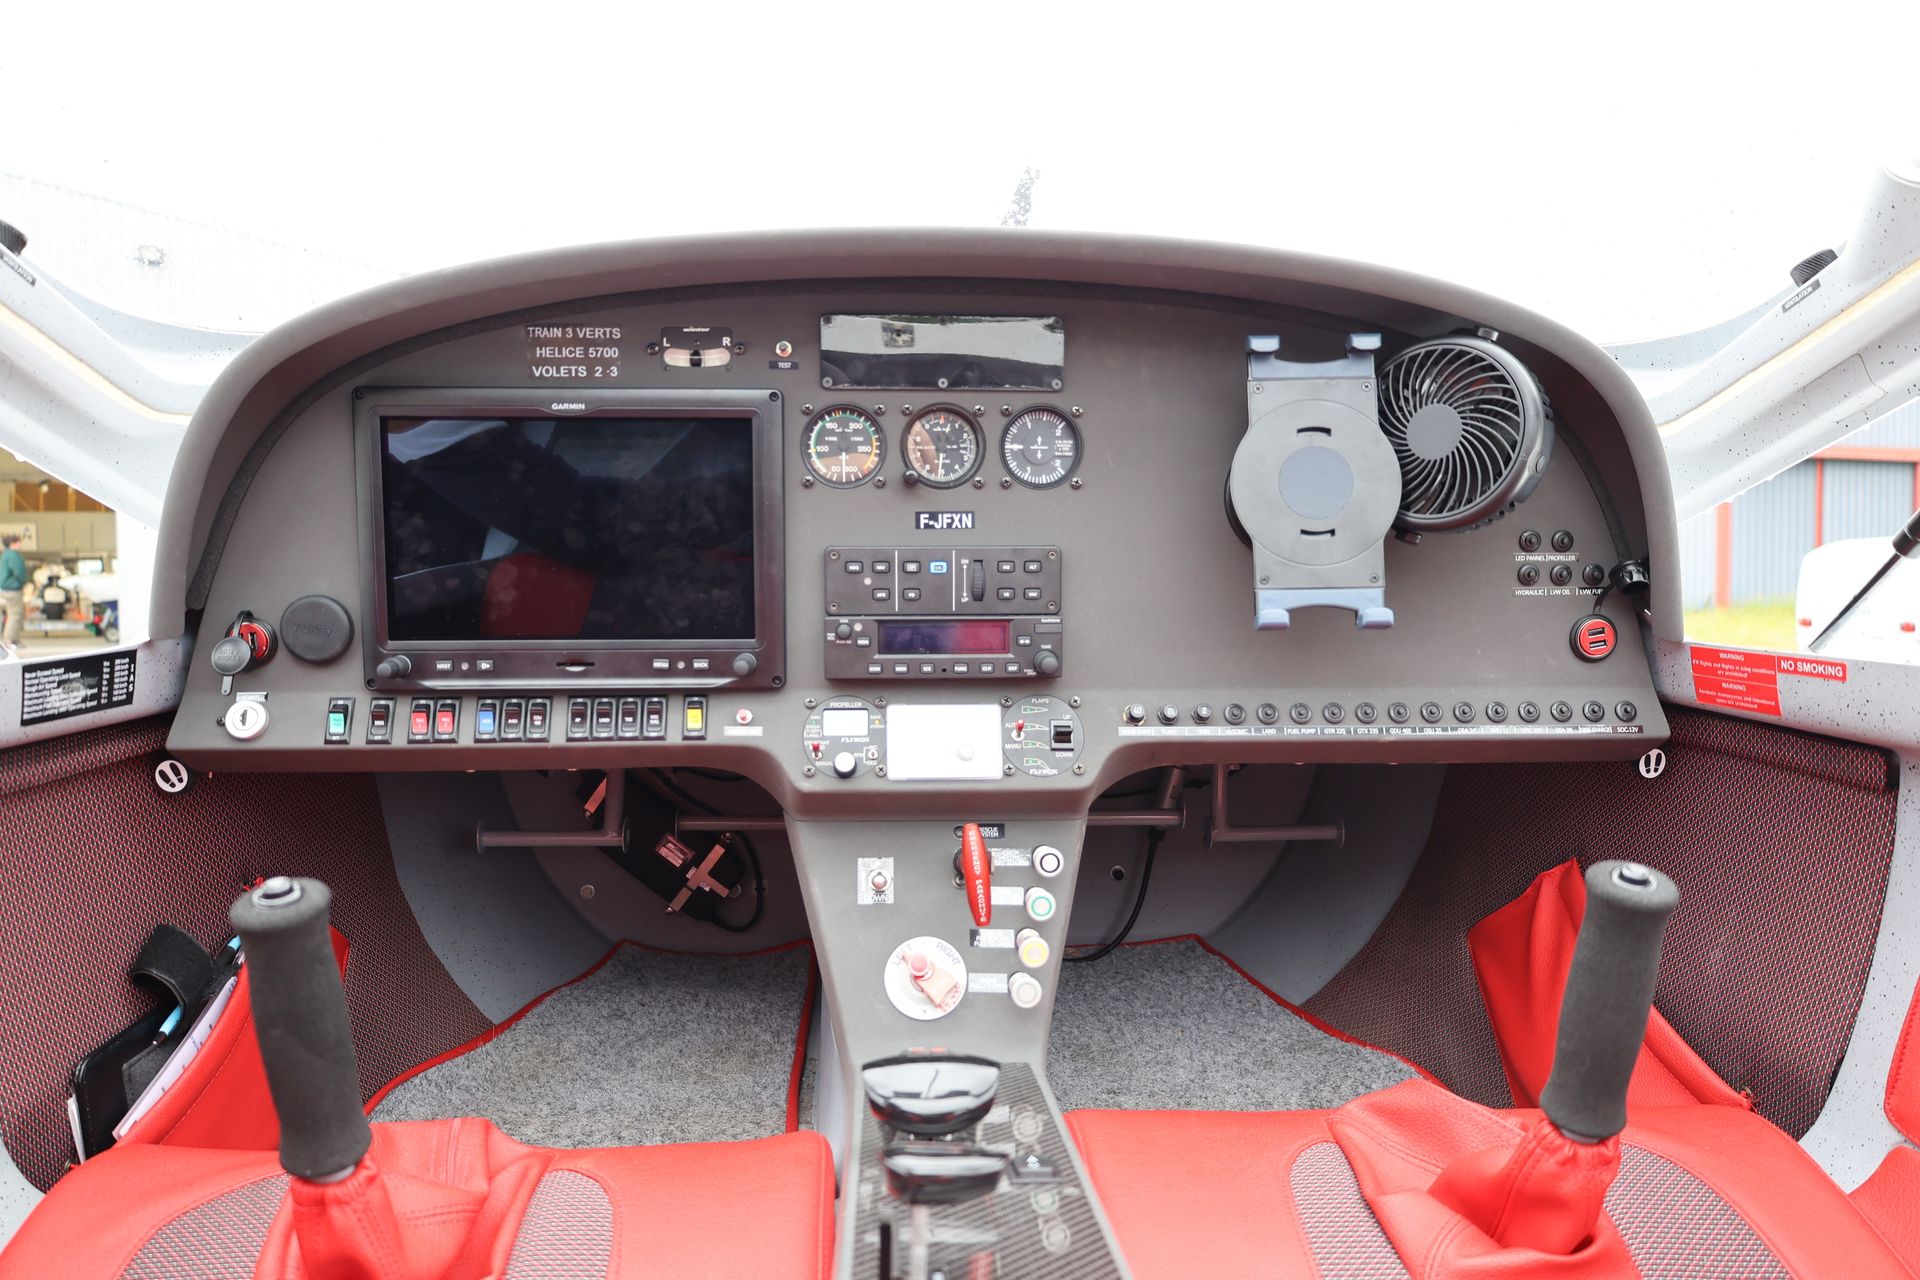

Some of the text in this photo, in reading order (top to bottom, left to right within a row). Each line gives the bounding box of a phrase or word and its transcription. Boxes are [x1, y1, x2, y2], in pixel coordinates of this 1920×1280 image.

[527, 327, 621, 339] TRAIN 3 VERTS
[663, 337, 731, 346] L R
[536, 347, 619, 358] HELICE 5700
[532, 365, 587, 377] VOLETS
[920, 514, 972, 528] F-JFXN
[1719, 653, 1744, 661] WARNING
[1781, 660, 1843, 677] NO SMOKING
[1721, 682, 1746, 691] WARNING
[968, 830, 981, 875] EMERGENCY
[936, 941, 961, 966] RIGHT
